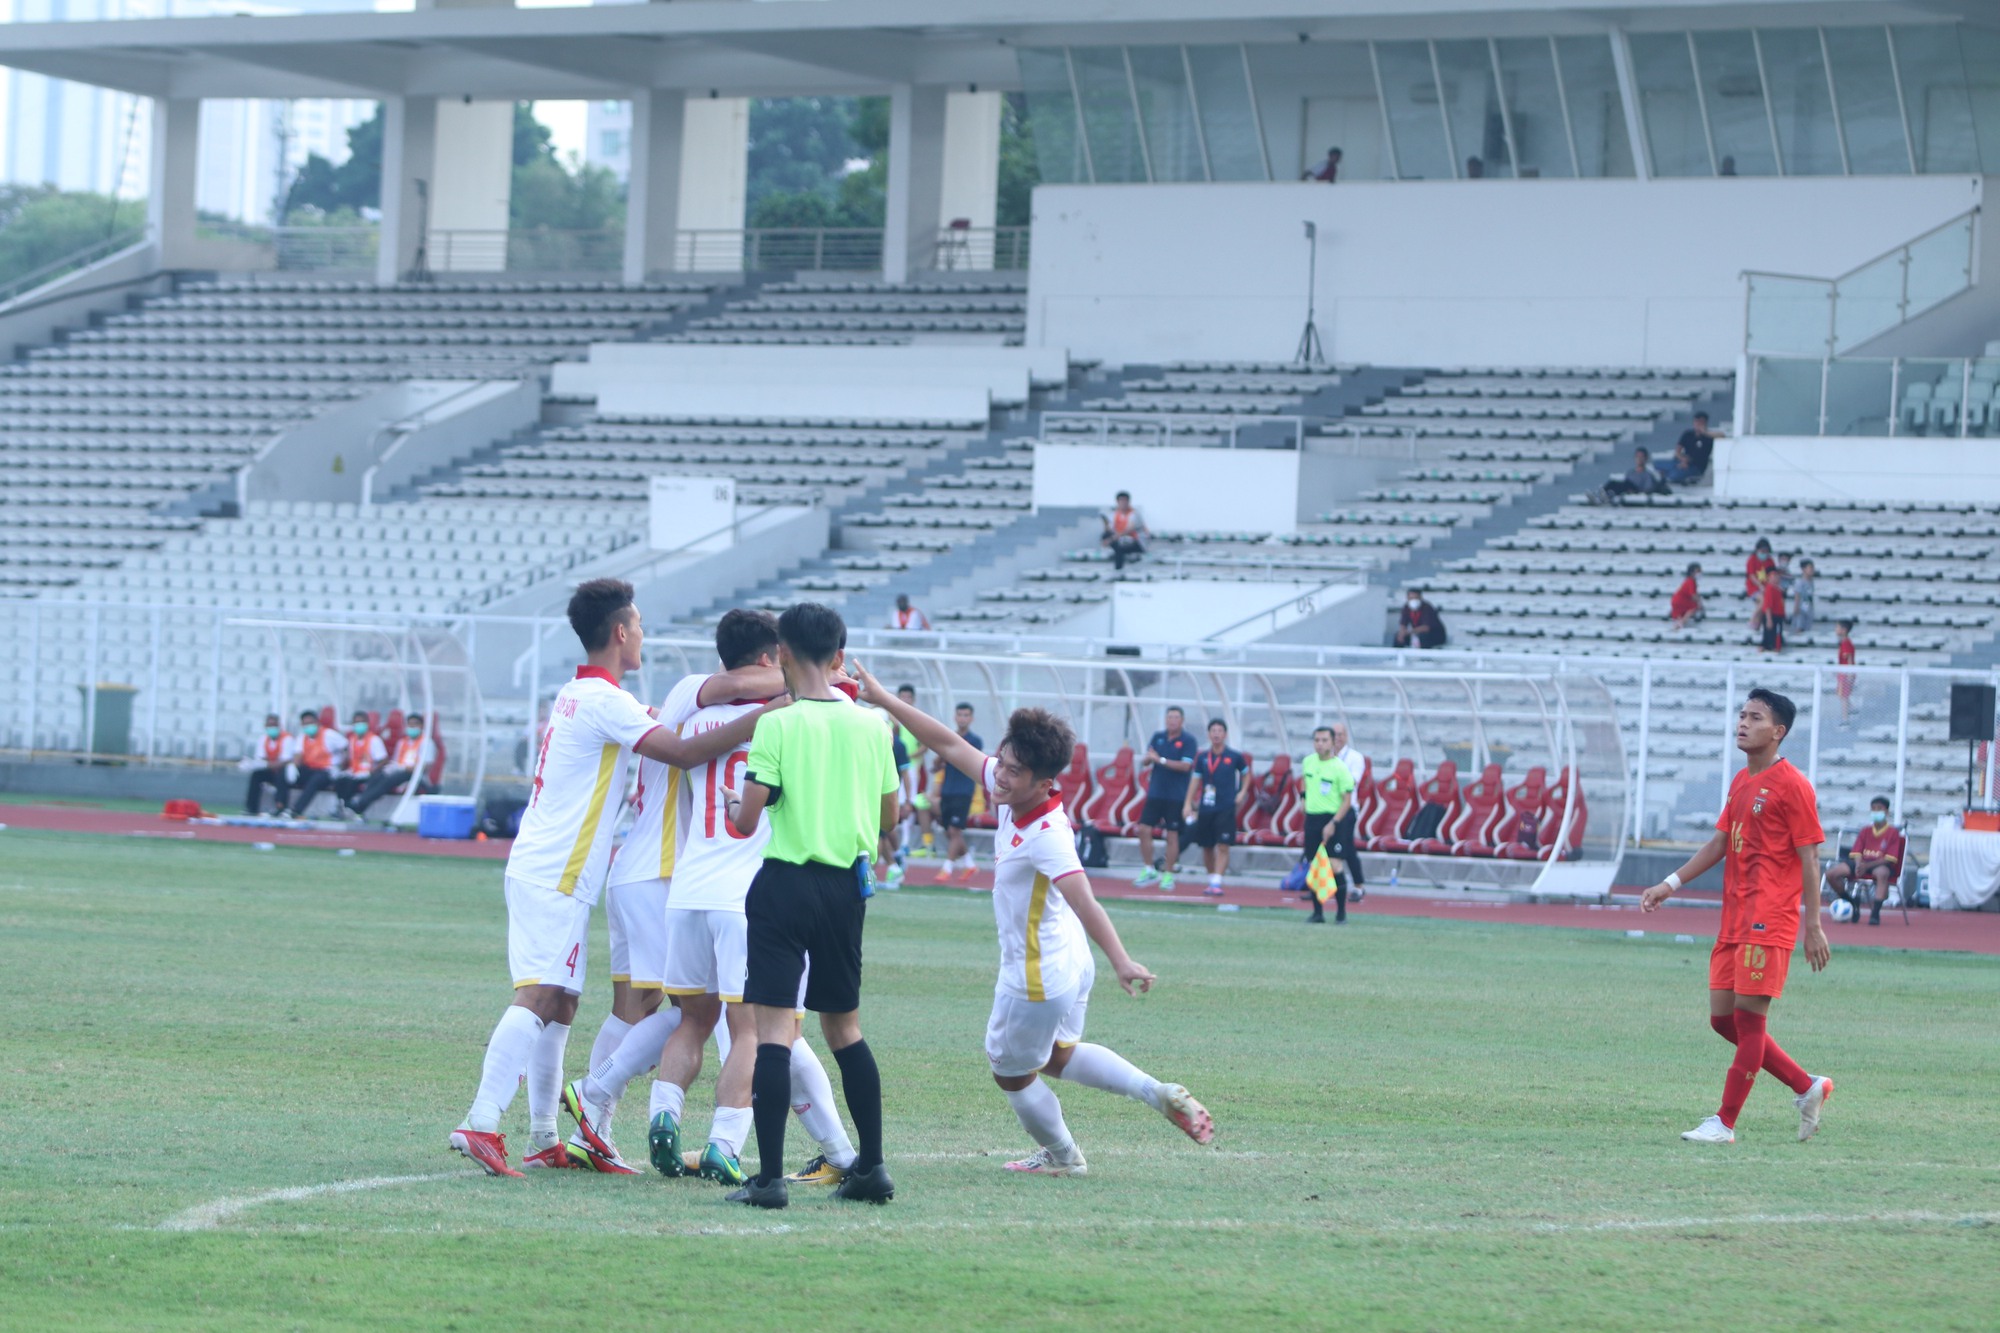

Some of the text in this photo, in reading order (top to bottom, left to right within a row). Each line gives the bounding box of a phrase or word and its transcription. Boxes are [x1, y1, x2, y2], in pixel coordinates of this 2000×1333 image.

[1731, 820, 1744, 853] 16
[566, 942, 580, 978] 4
[1743, 944, 1767, 969] 16
